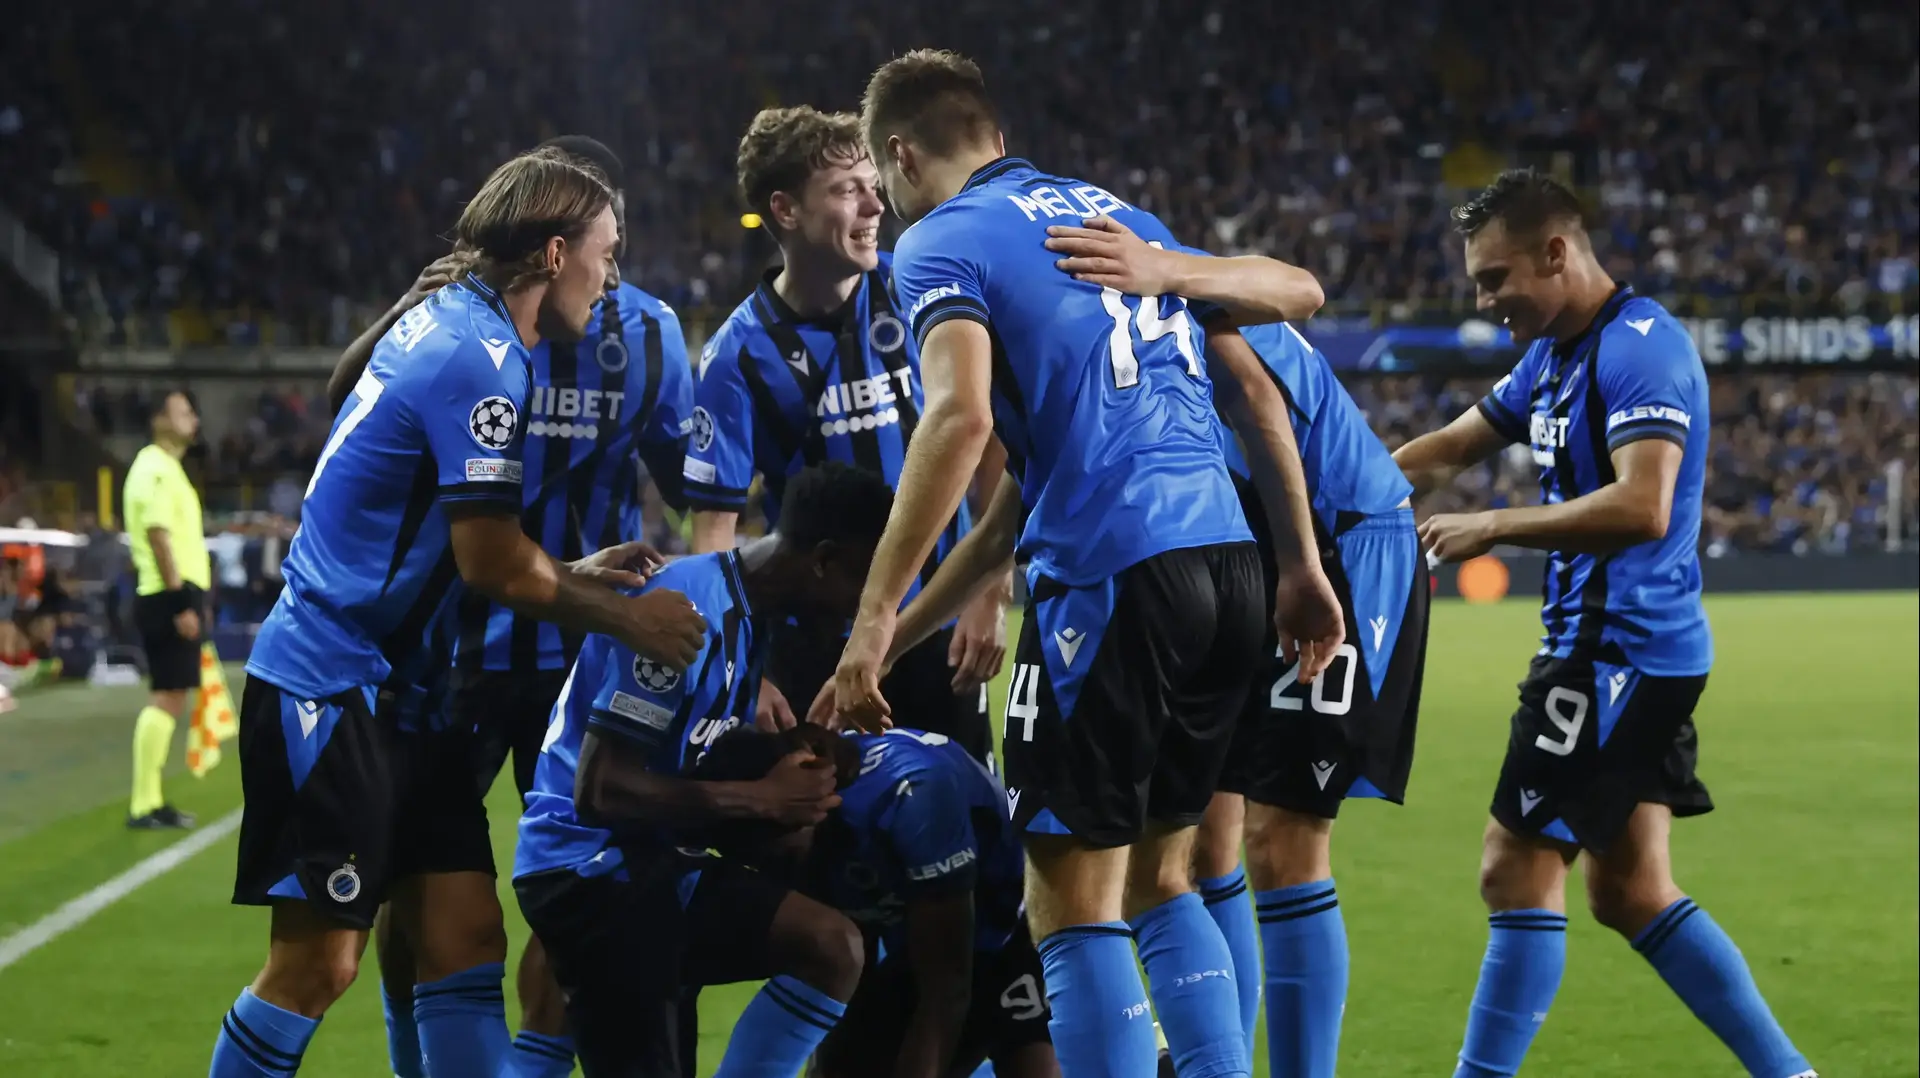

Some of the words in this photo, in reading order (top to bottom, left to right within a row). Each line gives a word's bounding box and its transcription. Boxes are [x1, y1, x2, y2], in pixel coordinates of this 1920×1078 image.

[1100, 240, 1200, 388] 14
[1741, 315, 1872, 364] SINDS
[303, 366, 385, 501] 7
[1608, 405, 1691, 428] ELEVEN
[1270, 639, 1358, 716] 20
[1535, 686, 1589, 756] 9
